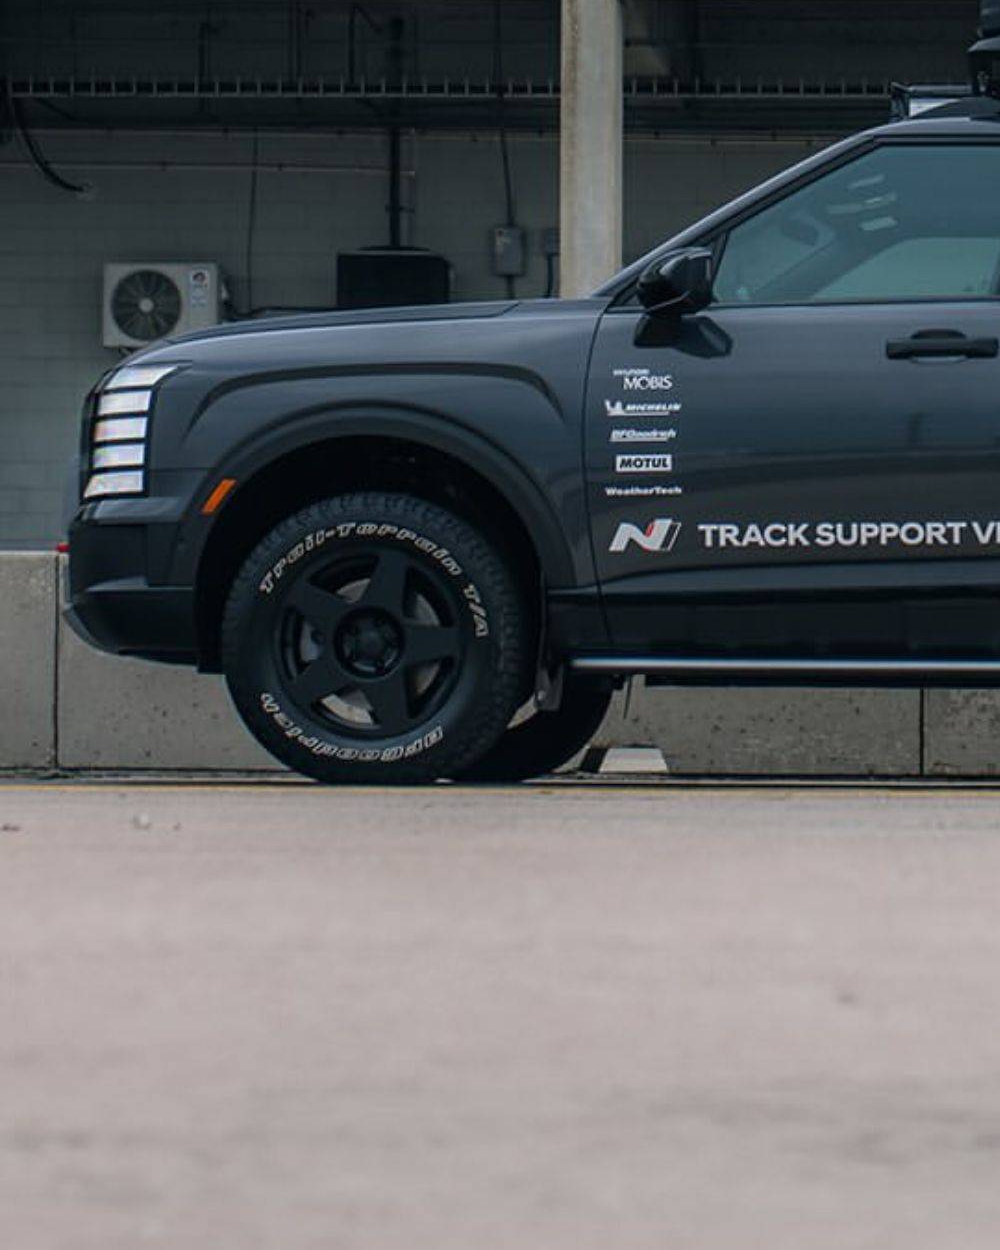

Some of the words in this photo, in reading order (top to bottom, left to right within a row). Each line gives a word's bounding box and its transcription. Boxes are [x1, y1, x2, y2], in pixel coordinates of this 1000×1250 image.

[623, 376, 673, 391] MOBIS
[624, 402, 682, 411] MICHELIN
[619, 457, 669, 469] MOTUL
[605, 485, 682, 496] WeatherTech
[698, 523, 811, 548] TRACK
[814, 521, 968, 546] SUPPORT
[464, 584, 489, 637] T/A
